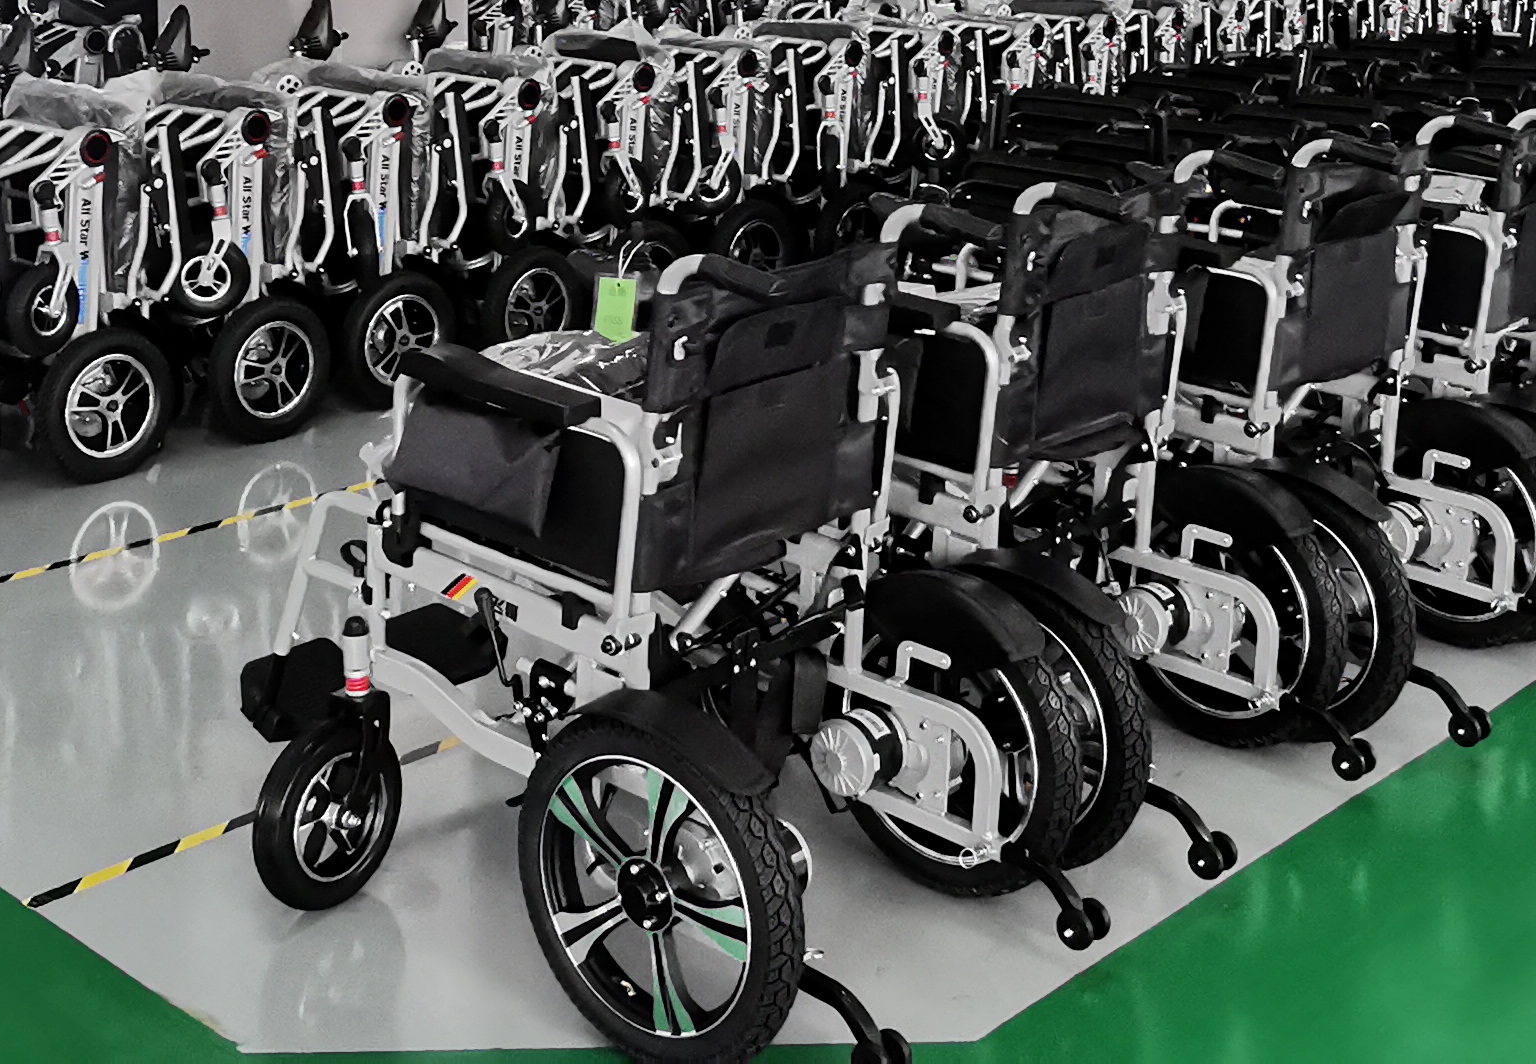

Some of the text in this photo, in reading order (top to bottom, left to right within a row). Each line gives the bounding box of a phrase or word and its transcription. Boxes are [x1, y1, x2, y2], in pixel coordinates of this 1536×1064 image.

[514, 135, 523, 151] All
[381, 154, 390, 170] All
[242, 175, 253, 193] All
[380, 173, 390, 198] Star
[80, 197, 92, 216] All
[241, 195, 252, 223] Star
[79, 219, 91, 247] Star
